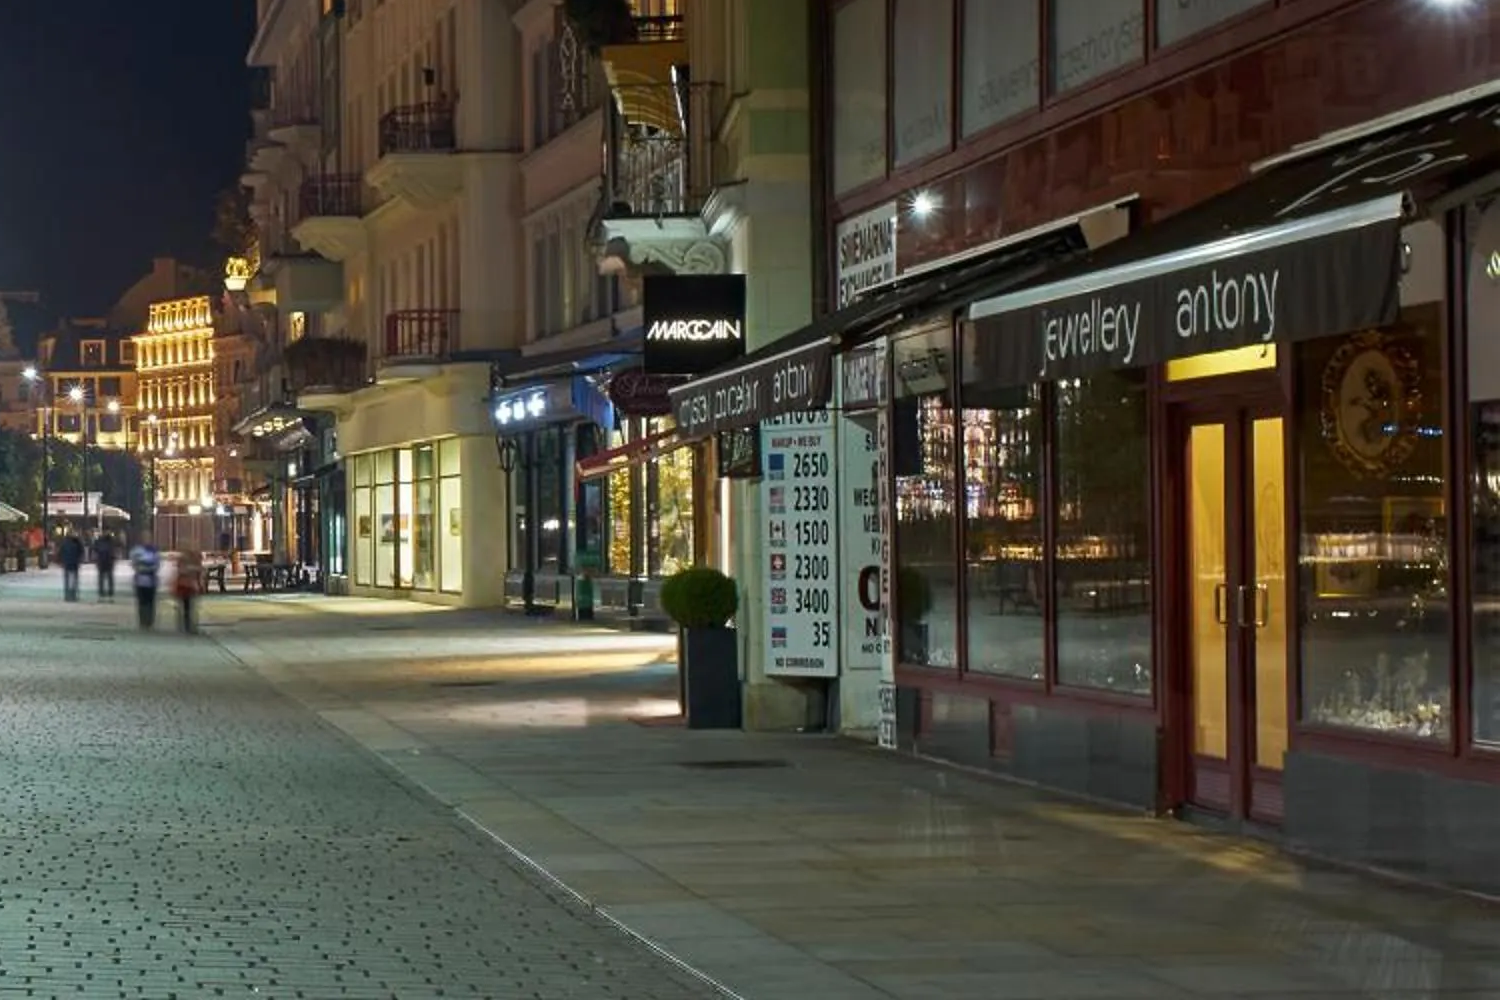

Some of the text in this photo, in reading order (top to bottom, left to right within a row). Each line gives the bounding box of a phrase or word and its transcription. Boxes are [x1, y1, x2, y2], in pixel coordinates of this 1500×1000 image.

[1038, 269, 1280, 377] jewellery antony
[793, 452, 829, 478] 2650
[794, 485, 829, 511] 2330
[795, 519, 829, 546] 1500
[794, 554, 829, 581] 2300
[795, 588, 830, 615] 3400
[812, 621, 830, 648] 35
